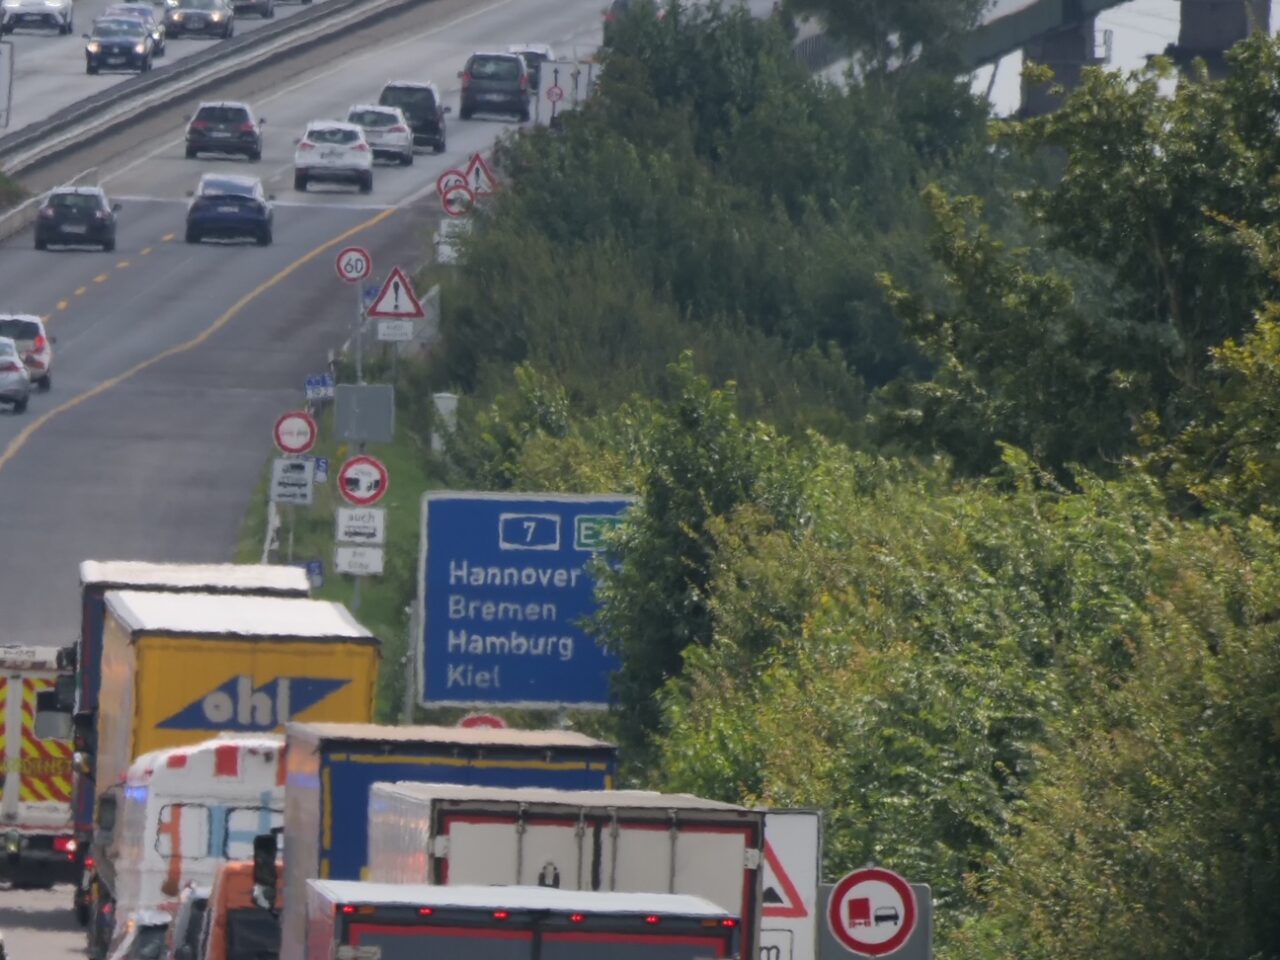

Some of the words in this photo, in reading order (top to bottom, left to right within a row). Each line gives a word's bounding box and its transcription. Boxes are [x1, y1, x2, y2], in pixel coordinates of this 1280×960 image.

[344, 258, 364, 274] 60
[523, 521, 536, 542] 7
[449, 559, 582, 587] Hannover
[448, 594, 557, 620] Bremen
[447, 629, 574, 661] Hamburg
[446, 663, 501, 689] Kiel
[202, 675, 290, 726] ohl
